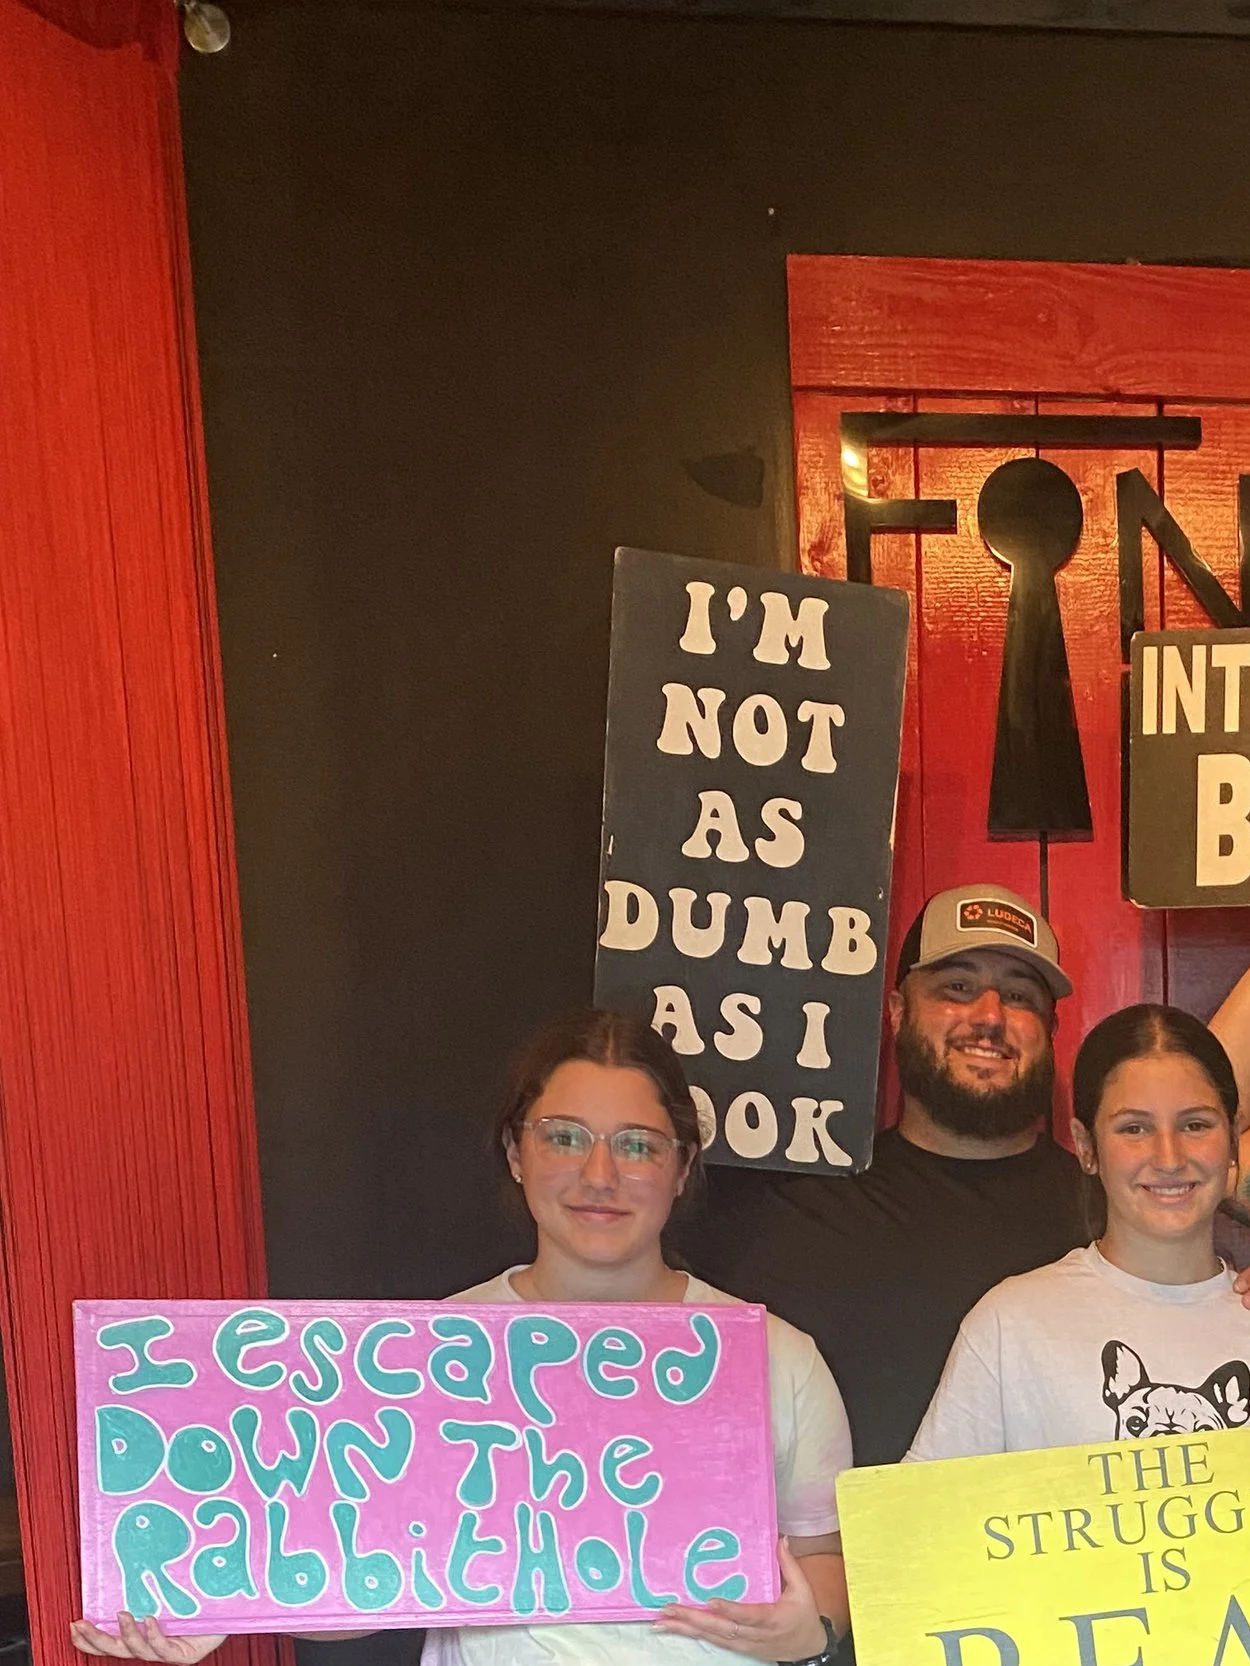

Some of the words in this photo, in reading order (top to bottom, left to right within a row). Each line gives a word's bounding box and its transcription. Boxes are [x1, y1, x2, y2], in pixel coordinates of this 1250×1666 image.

[679, 581, 832, 671] I'M
[656, 682, 846, 774] NOT
[681, 790, 805, 868] AS
[599, 880, 878, 976] DUMB
[651, 985, 764, 1061] AS
[796, 1001, 831, 1069] I
[97, 1315, 197, 1394] I
[211, 1307, 722, 1427] escaped
[440, 1418, 664, 1511] The
[1088, 1442, 1215, 1495] THE
[1140, 1548, 1192, 1595] IS
